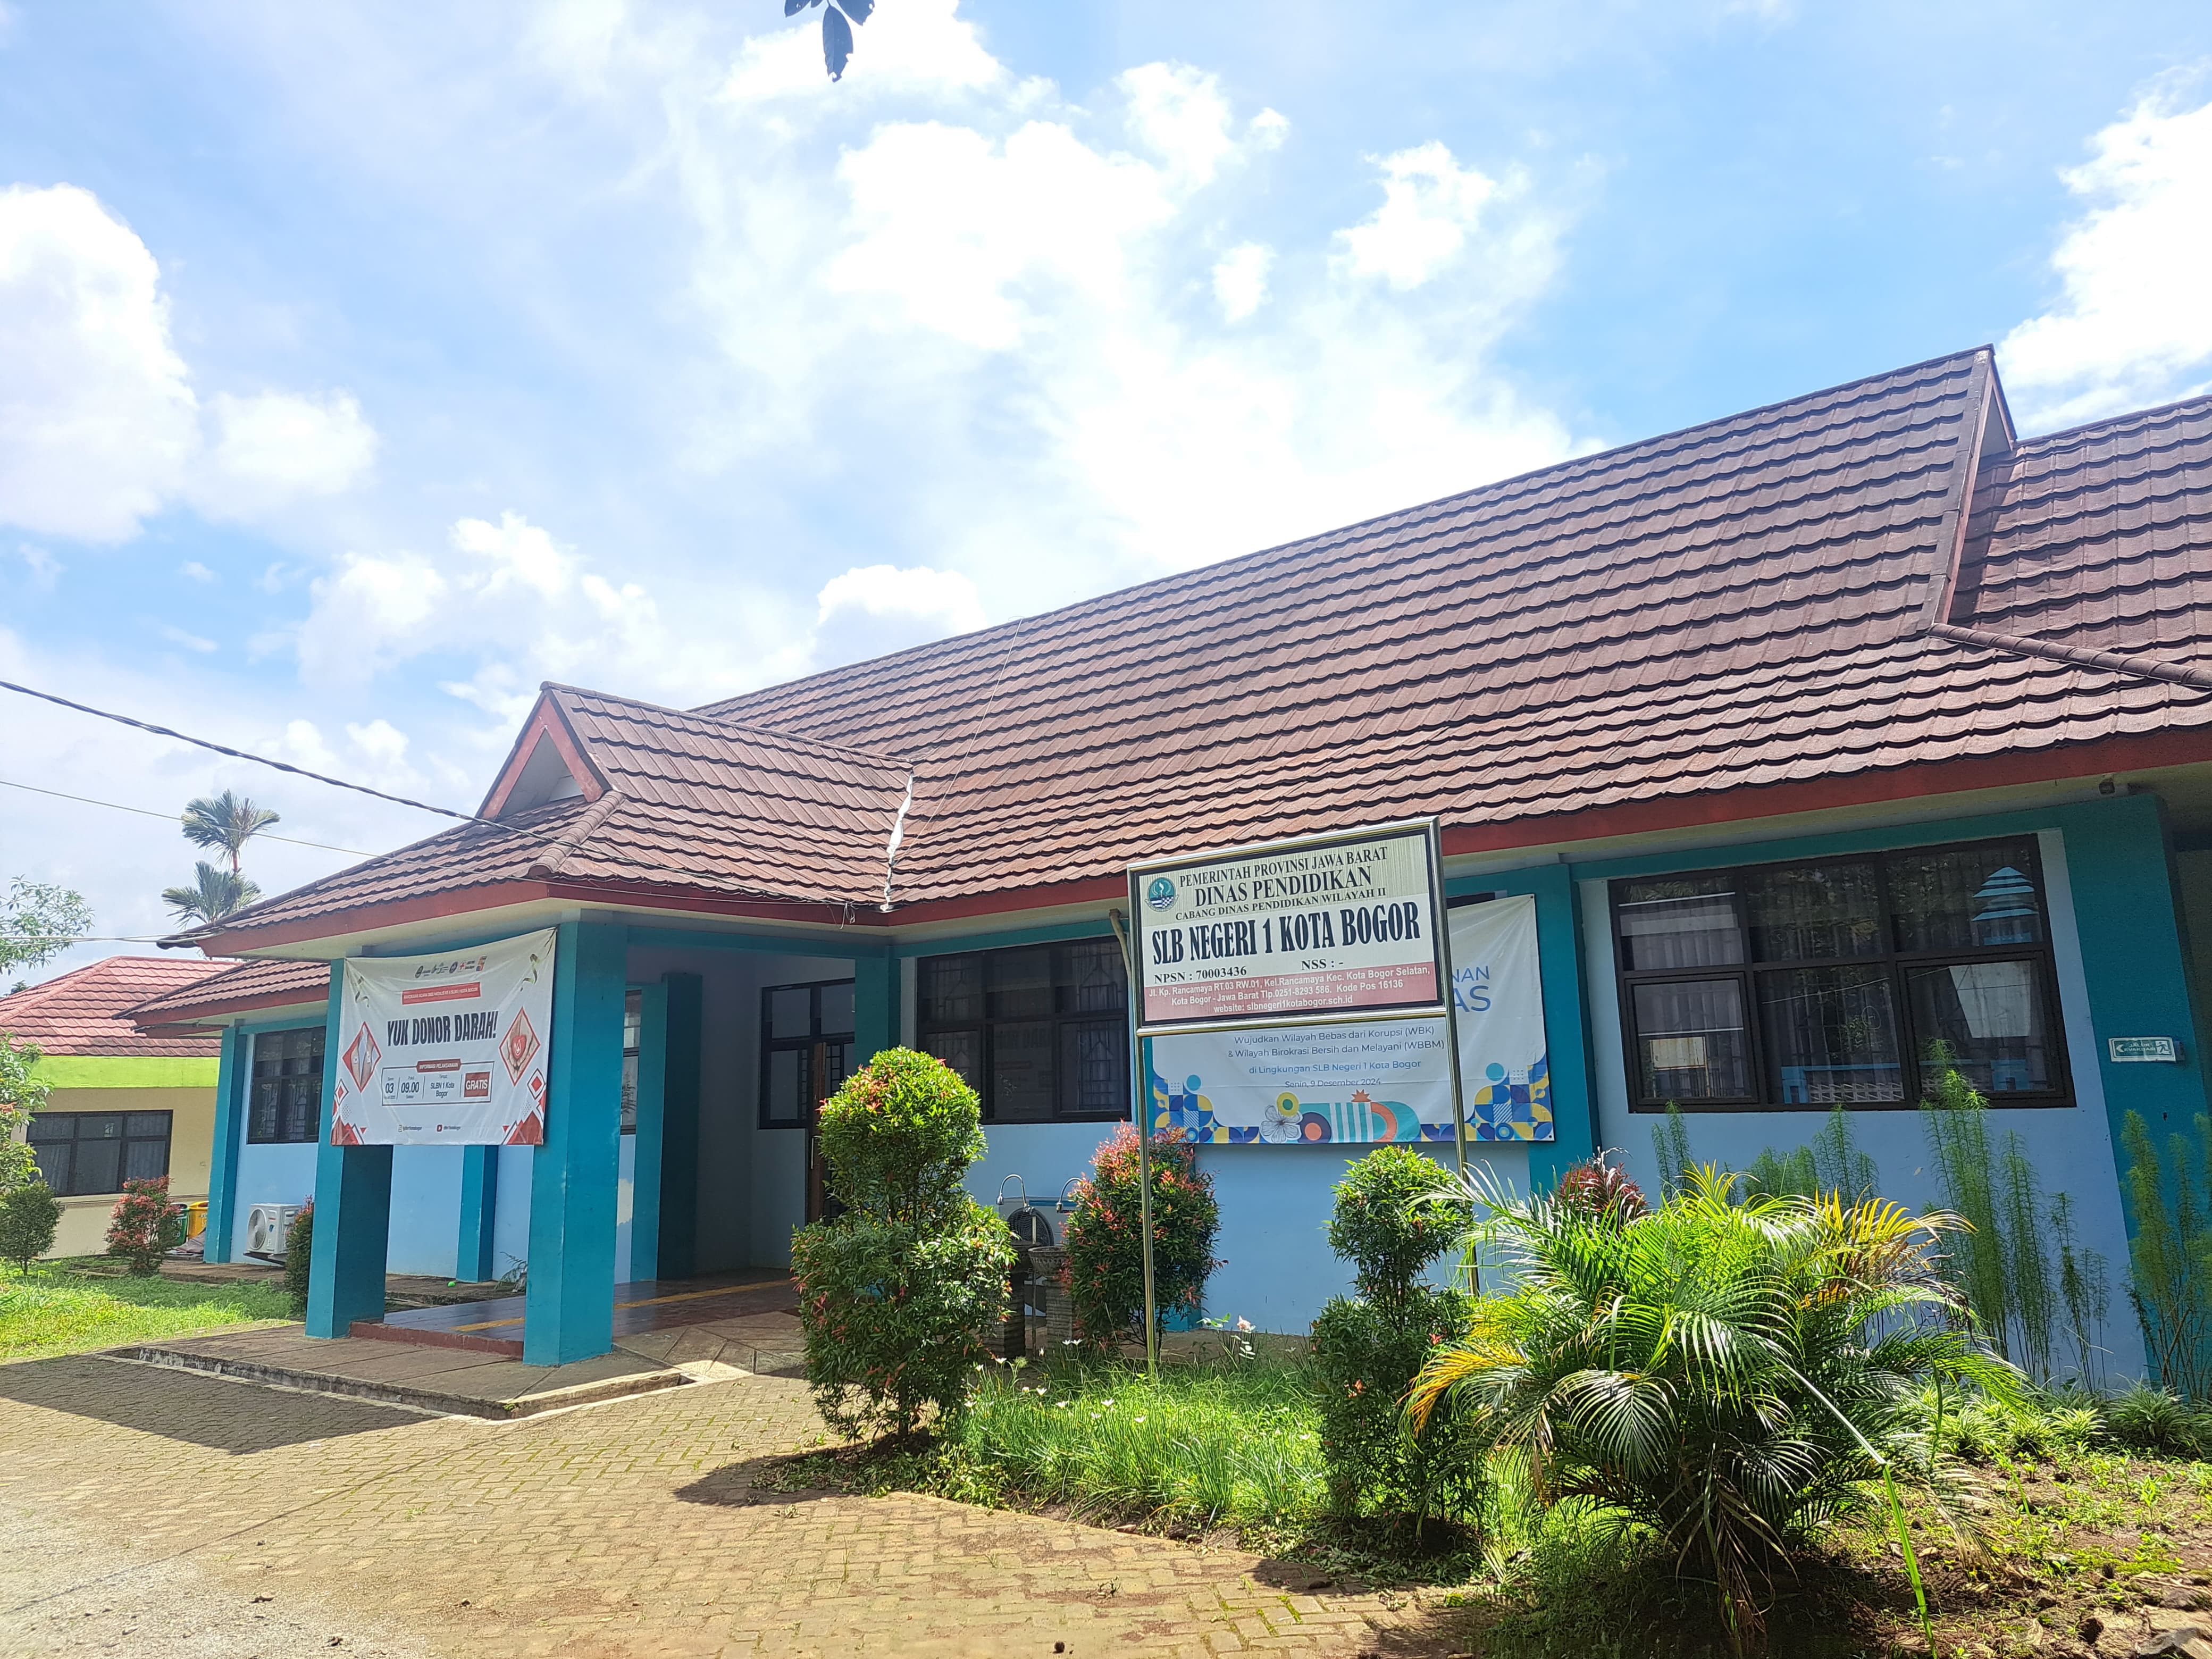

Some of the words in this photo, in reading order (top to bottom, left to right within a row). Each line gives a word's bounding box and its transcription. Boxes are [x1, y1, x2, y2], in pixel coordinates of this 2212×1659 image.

[1180, 866, 1251, 887] PEMERINTAH
[1254, 858, 1309, 877] PROVINSI
[1312, 853, 1344, 870] JAWA
[1346, 847, 1387, 865] BARAT
[1195, 882, 1247, 907] DINAS
[1252, 866, 1372, 900] PENDIDIKAN
[1176, 908, 1216, 920] CABANG
[1218, 904, 1249, 915] DINAS
[1252, 895, 1319, 911] PENDIDIKAN
[1321, 889, 1374, 902] WILAYAH
[1378, 887, 1387, 896] II
[1152, 928, 1184, 965] SLB
[1189, 919, 1258, 961] NEGERI
[1262, 918, 1272, 953] 1
[1279, 911, 1335, 952] KOTA
[1340, 901, 1420, 946] BOGOR
[1301, 959, 1327, 970] NSS
[1149, 988, 1158, 997] Jl.
[1159, 987, 1170, 997] Kp.
[1172, 986, 1212, 995] Rancamaya
[1214, 982, 1234, 991] RT.03
[1236, 979, 1262, 989] RW.01,
[1264, 975, 1324, 987] Kel.Rancamaya
[1346, 971, 1365, 979] Kota
[1368, 969, 1394, 980] Bogor
[1396, 966, 1430, 976] Selatan,
[1154, 972, 1186, 984] NPSN
[1196, 966, 1247, 979] 70003436
[1190, 996, 1211, 1005] Bogor
[1217, 993, 1236, 1002] Jawa
[1238, 991, 1259, 1000] Barat
[1315, 986, 1332, 994] 586.
[1336, 984, 1358, 992] Kode
[1360, 982, 1376, 990] Pos
[1378, 979, 1403, 989] 16136
[1213, 1003, 1244, 1013] website:
[1247, 995, 1353, 1011] slbnegeri1kotabogor.sch.id
[388, 1019, 409, 1046] YUK
[412, 1016, 450, 1045] DONOR
[454, 1011, 499, 1042] DARAH!
[1234, 1035, 1279, 1045] Wujudkan
[1281, 1033, 1316, 1043] Wilayah
[1319, 1032, 1346, 1040] Bebas
[1368, 1028, 1403, 1039] Korupsi
[1405, 1026, 1434, 1037] (WBK)
[1235, 1049, 1269, 1058] Wilayah
[1272, 1046, 1309, 1055] Birokrasi
[1312, 1045, 1339, 1054] Bersih
[1361, 1042, 1402, 1054] Melayani
[1404, 1039, 1444, 1051] (WBBM)
[1259, 1065, 1310, 1075] Lingkungan
[1332, 1062, 1361, 1072] Negeri
[1393, 1061, 1421, 1070] Bogor
[385, 1083, 394, 1094] 03
[401, 1082, 420, 1093] 09.00
[466, 1079, 488, 1090] GRATIS
